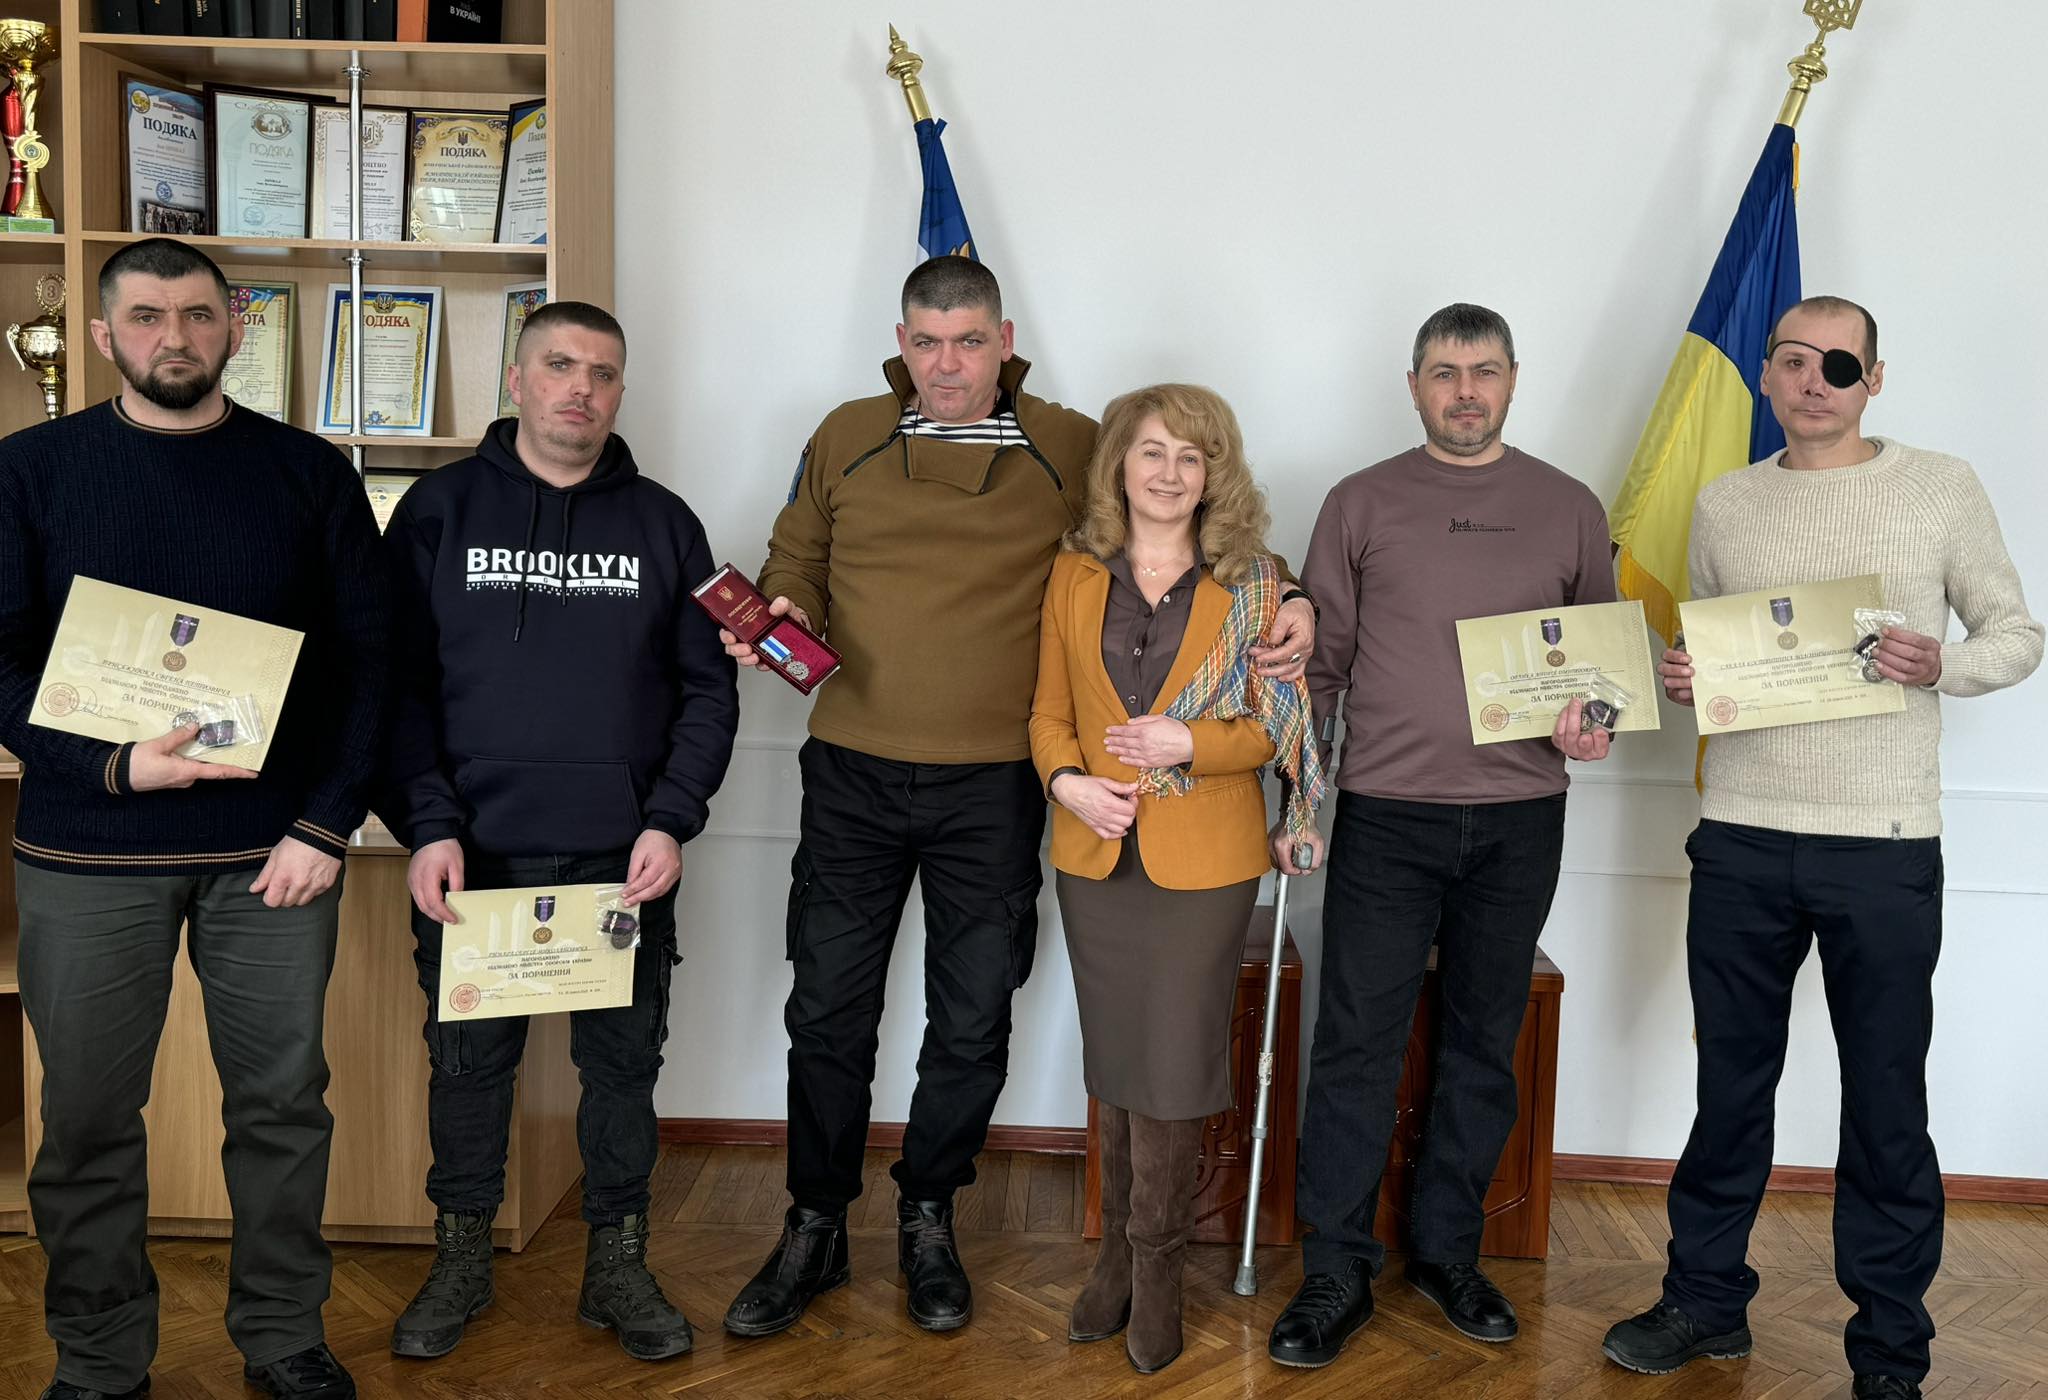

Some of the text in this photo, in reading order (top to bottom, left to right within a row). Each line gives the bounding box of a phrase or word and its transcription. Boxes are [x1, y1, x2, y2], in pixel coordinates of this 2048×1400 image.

[143, 116, 198, 140] ПОДЯКА
[440, 146, 487, 158] ПОДЯКА
[47, 285, 56, 298] 3
[363, 314, 411, 328] ОДЯКА
[467, 548, 639, 580] BROOKLYN
